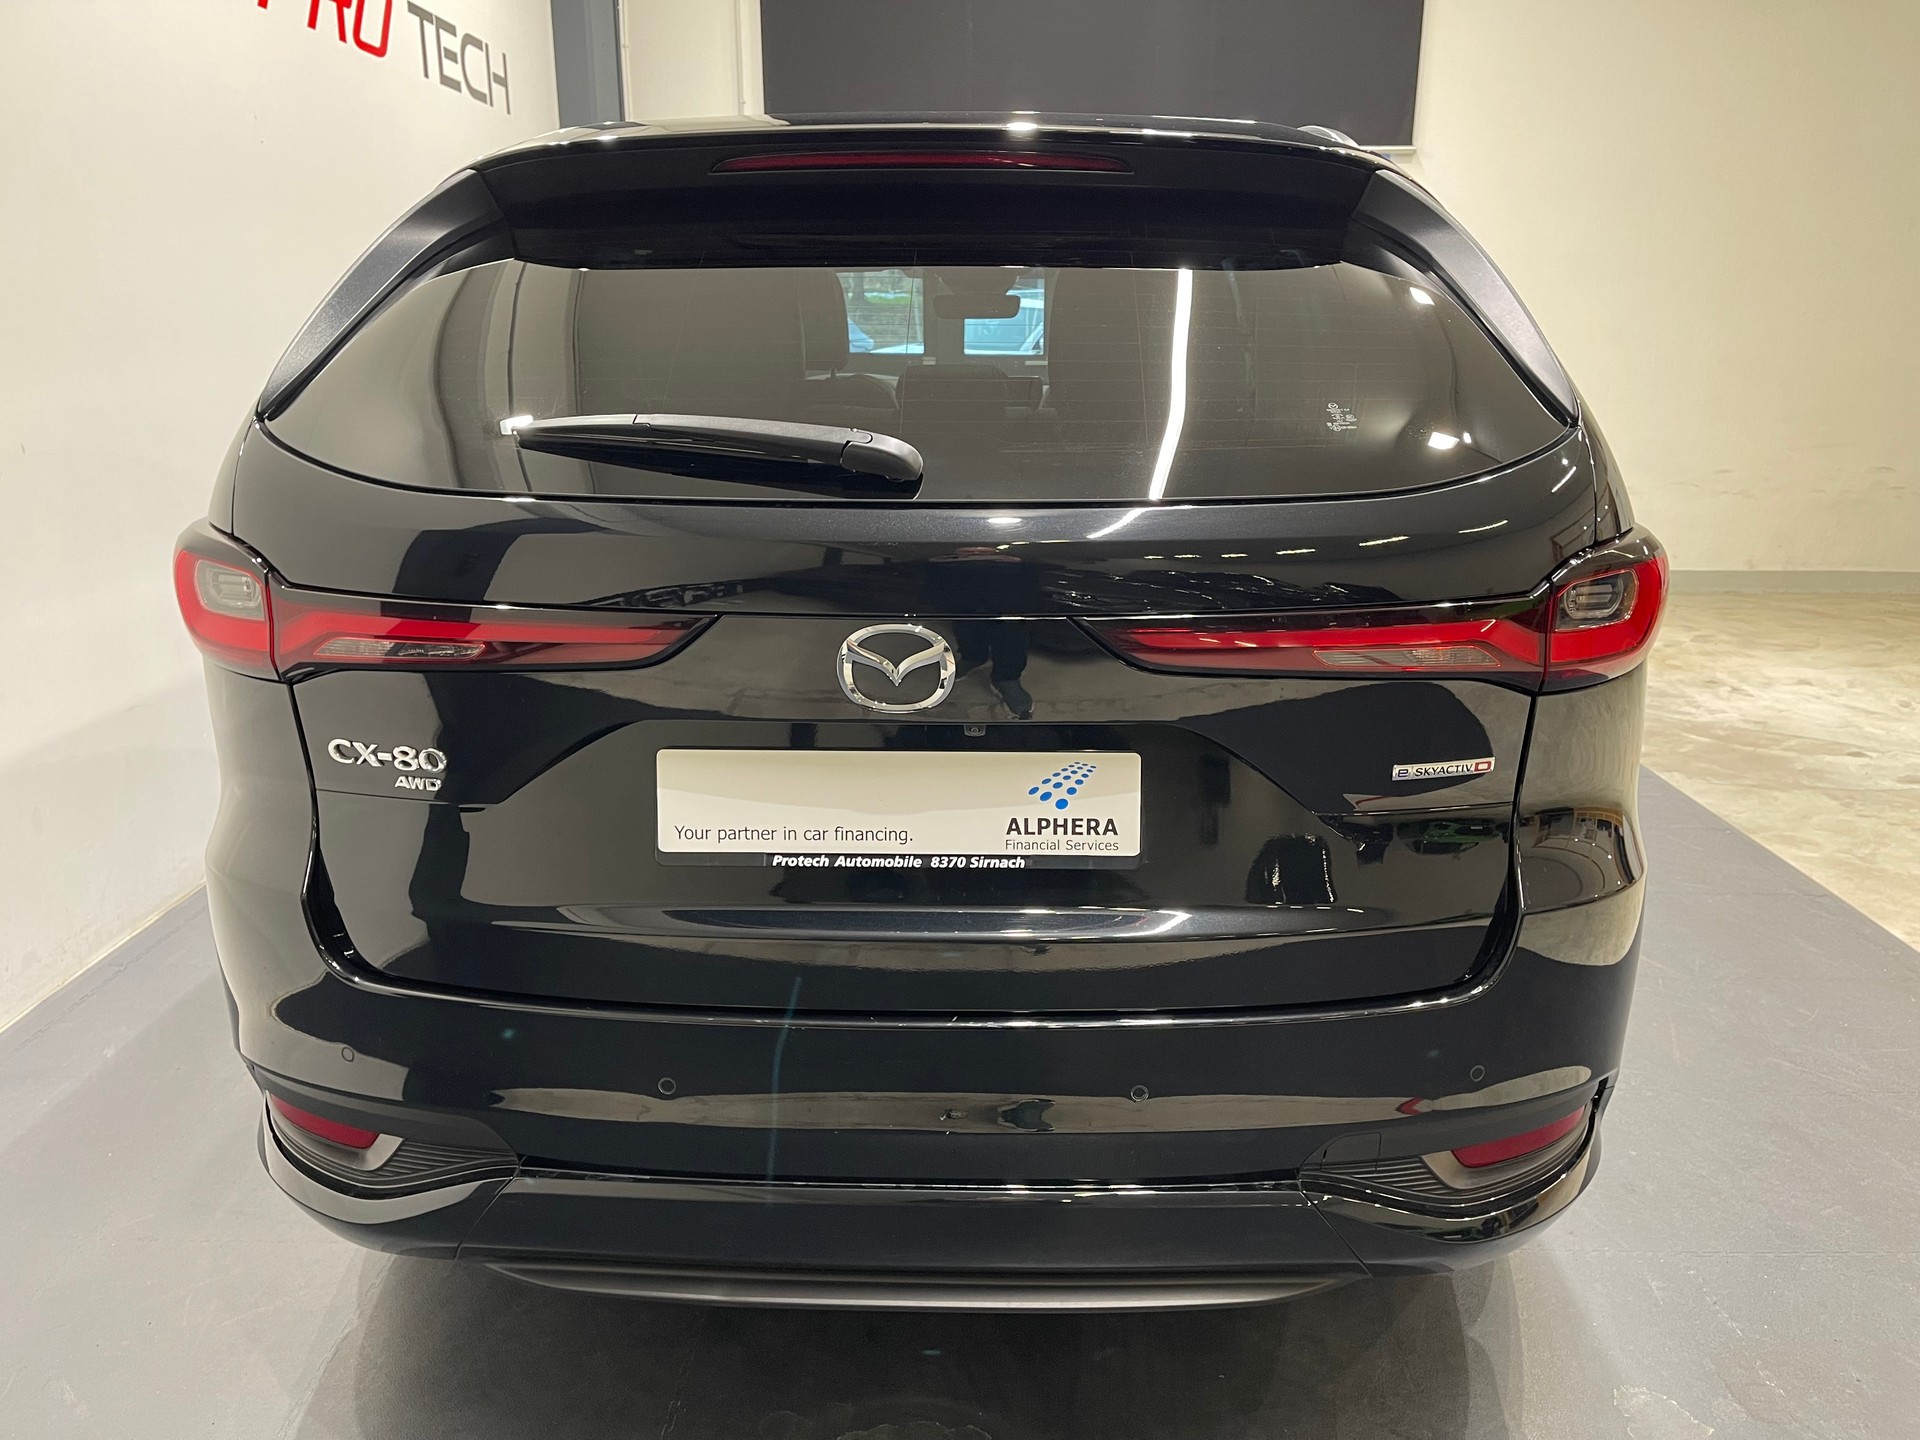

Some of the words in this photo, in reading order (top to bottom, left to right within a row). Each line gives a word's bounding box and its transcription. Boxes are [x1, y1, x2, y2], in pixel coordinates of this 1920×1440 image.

[407, 0, 511, 115] TECH
[327, 738, 448, 774] CX-80
[394, 775, 442, 791] AWD
[674, 825, 711, 841] Your
[717, 827, 777, 844] partner
[783, 826, 797, 841] in
[803, 829, 828, 841] car
[834, 826, 914, 845] financing.
[1005, 817, 1119, 836] ALPHERA
[1005, 839, 1060, 851] Financial
[1065, 839, 1119, 851] Services
[772, 854, 829, 868] Protech
[834, 854, 922, 868] Automobile
[930, 856, 966, 869] 8370
[969, 856, 1026, 869] Sirnach
